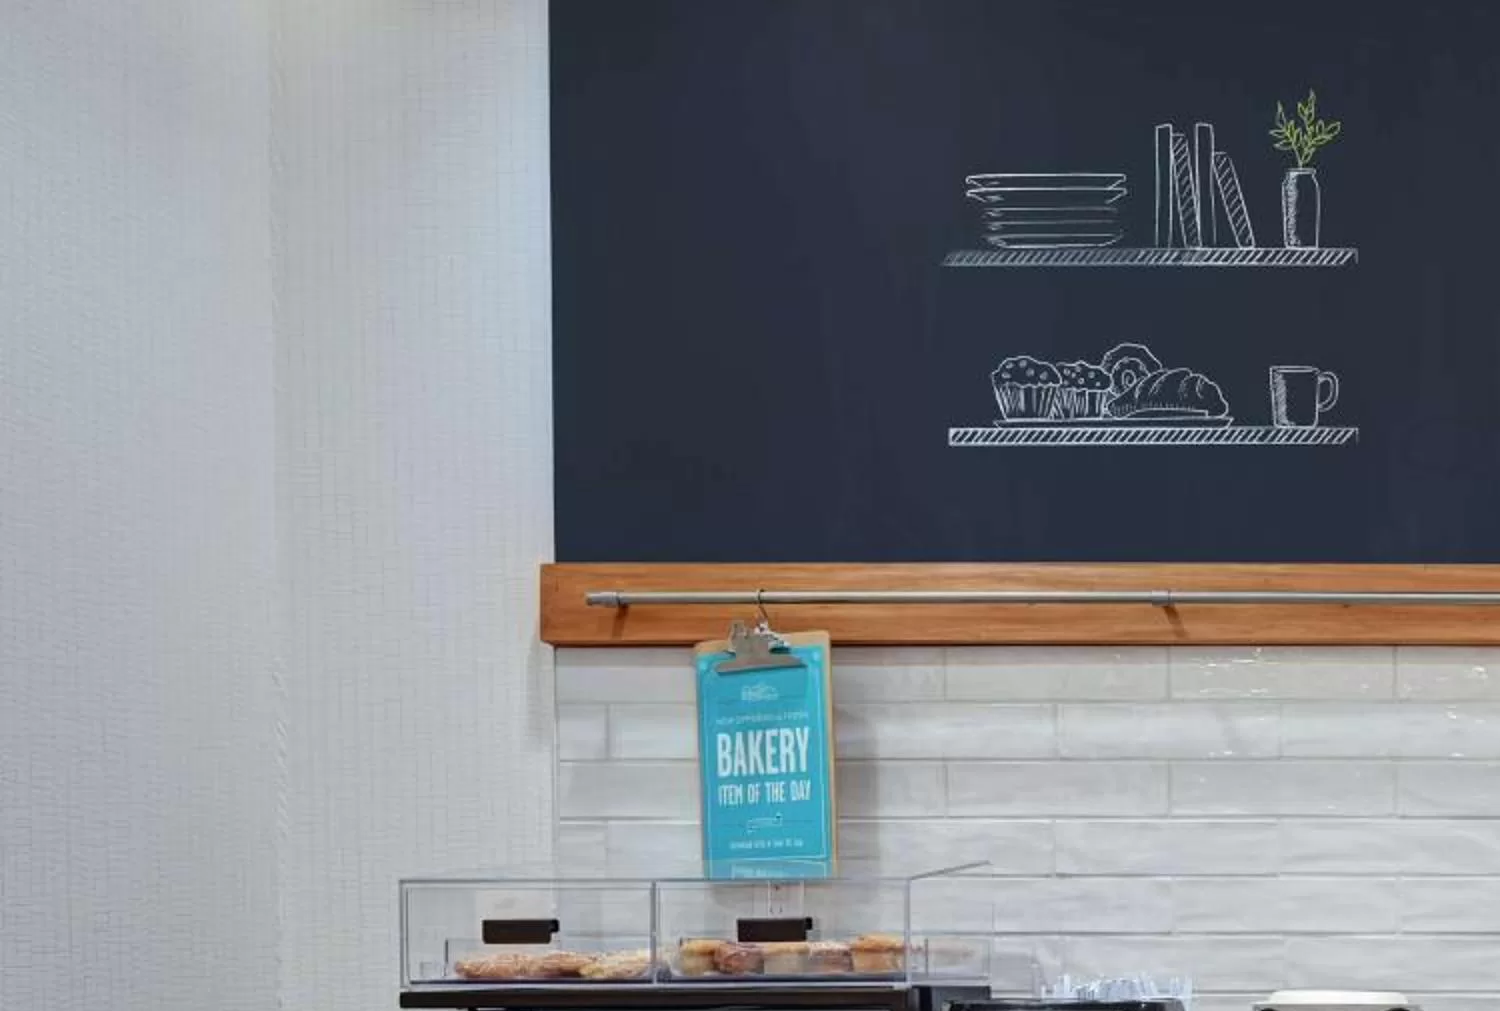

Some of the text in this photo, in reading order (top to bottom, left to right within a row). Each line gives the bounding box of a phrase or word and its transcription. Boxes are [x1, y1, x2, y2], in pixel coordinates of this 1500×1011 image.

[716, 725, 810, 778] BAKERY
[719, 779, 812, 807] ITEM OF THE DAY
